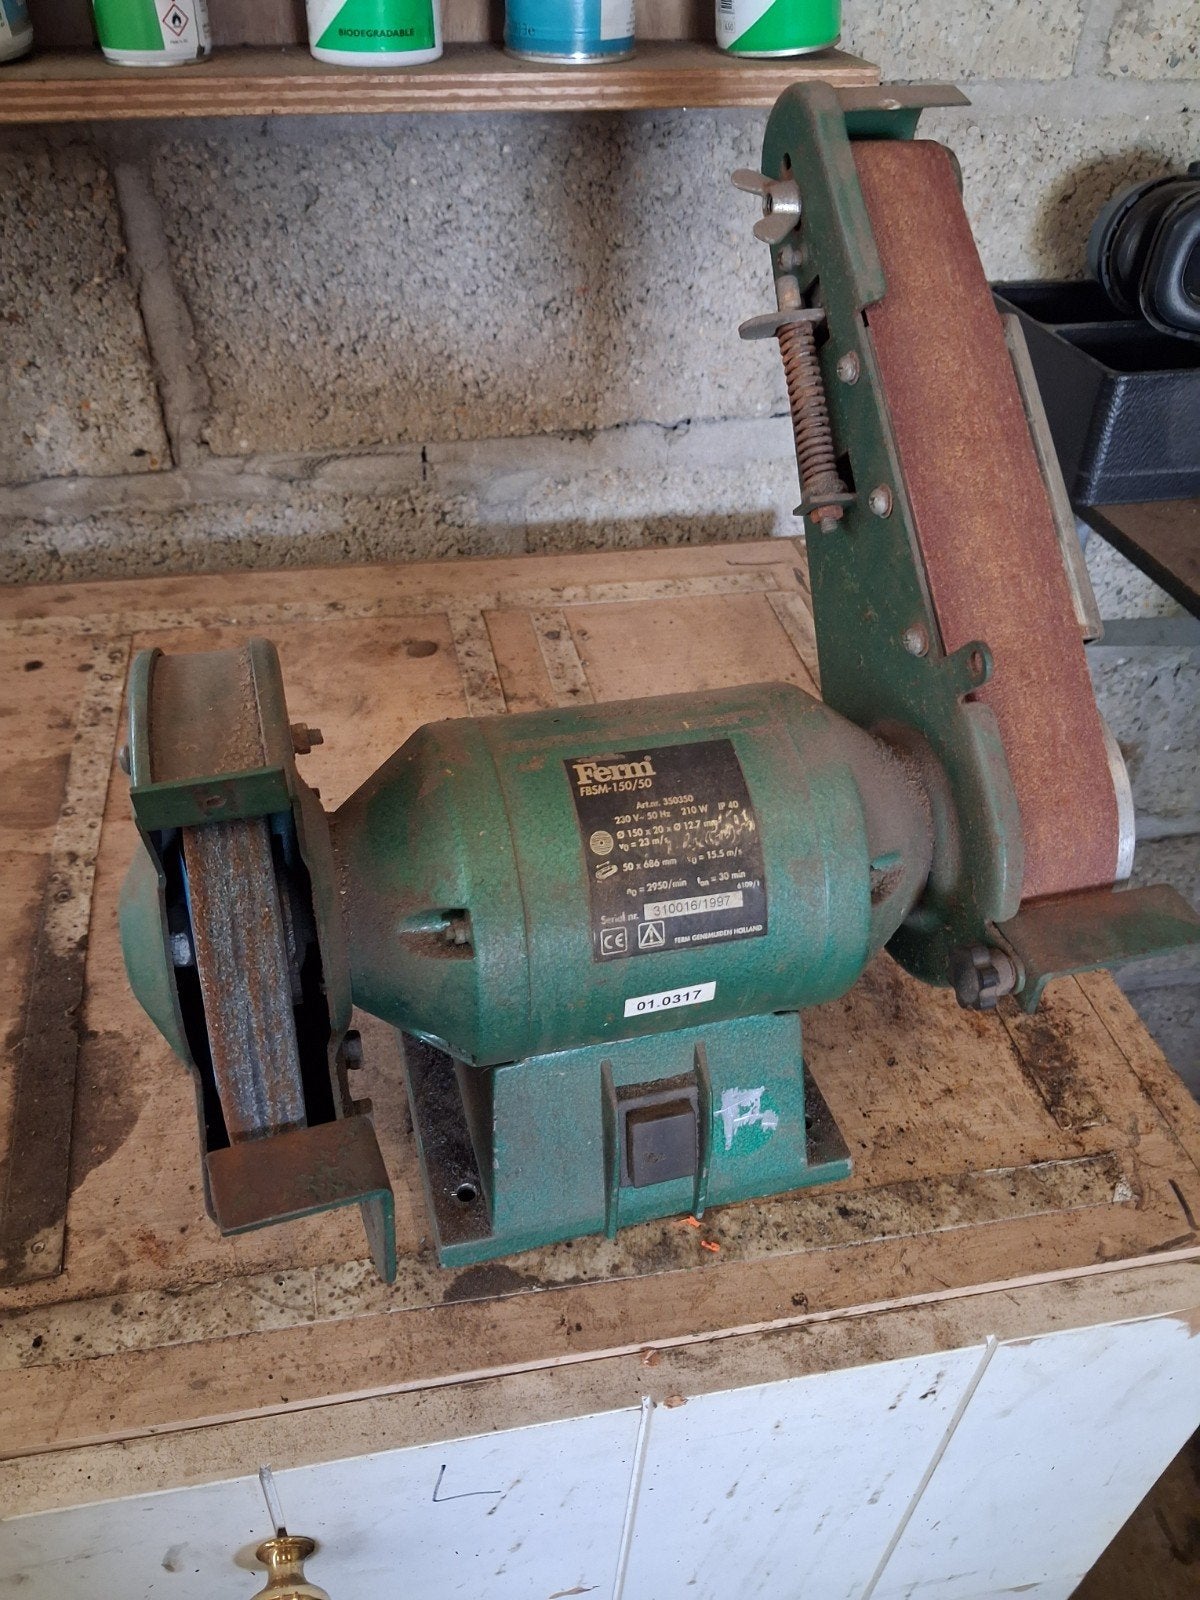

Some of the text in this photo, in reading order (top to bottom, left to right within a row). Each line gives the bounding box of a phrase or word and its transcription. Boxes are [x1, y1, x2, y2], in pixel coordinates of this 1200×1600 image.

[338, 28, 415, 38] BIODEGRADABLE
[580, 778, 653, 797] FBSM-150/50
[662, 794, 694, 807] 350350
[614, 814, 632, 825] 230
[647, 811, 658, 821] 50
[660, 810, 671, 818] Hz
[680, 806, 697, 816] 210
[697, 804, 708, 814] W
[718, 801, 726, 811] IP
[728, 800, 739, 810] 40
[626, 828, 643, 839] 150
[652, 825, 665, 835] 20
[684, 820, 700, 831] 12.7
[638, 838, 650, 848] 23
[622, 863, 634, 872] 50
[643, 858, 660, 869] 686
[661, 858, 677, 866] mm
[706, 849, 725, 860] 15.5
[646, 877, 687, 892] 2950/min
[718, 872, 730, 882] 30
[731, 870, 746, 879] min
[600, 895, 731, 925] Serial nr. 310016/1997
[674, 934, 691, 944] FERM
[733, 924, 763, 936] HOLLAND
[637, 989, 702, 1011] 01.0317
